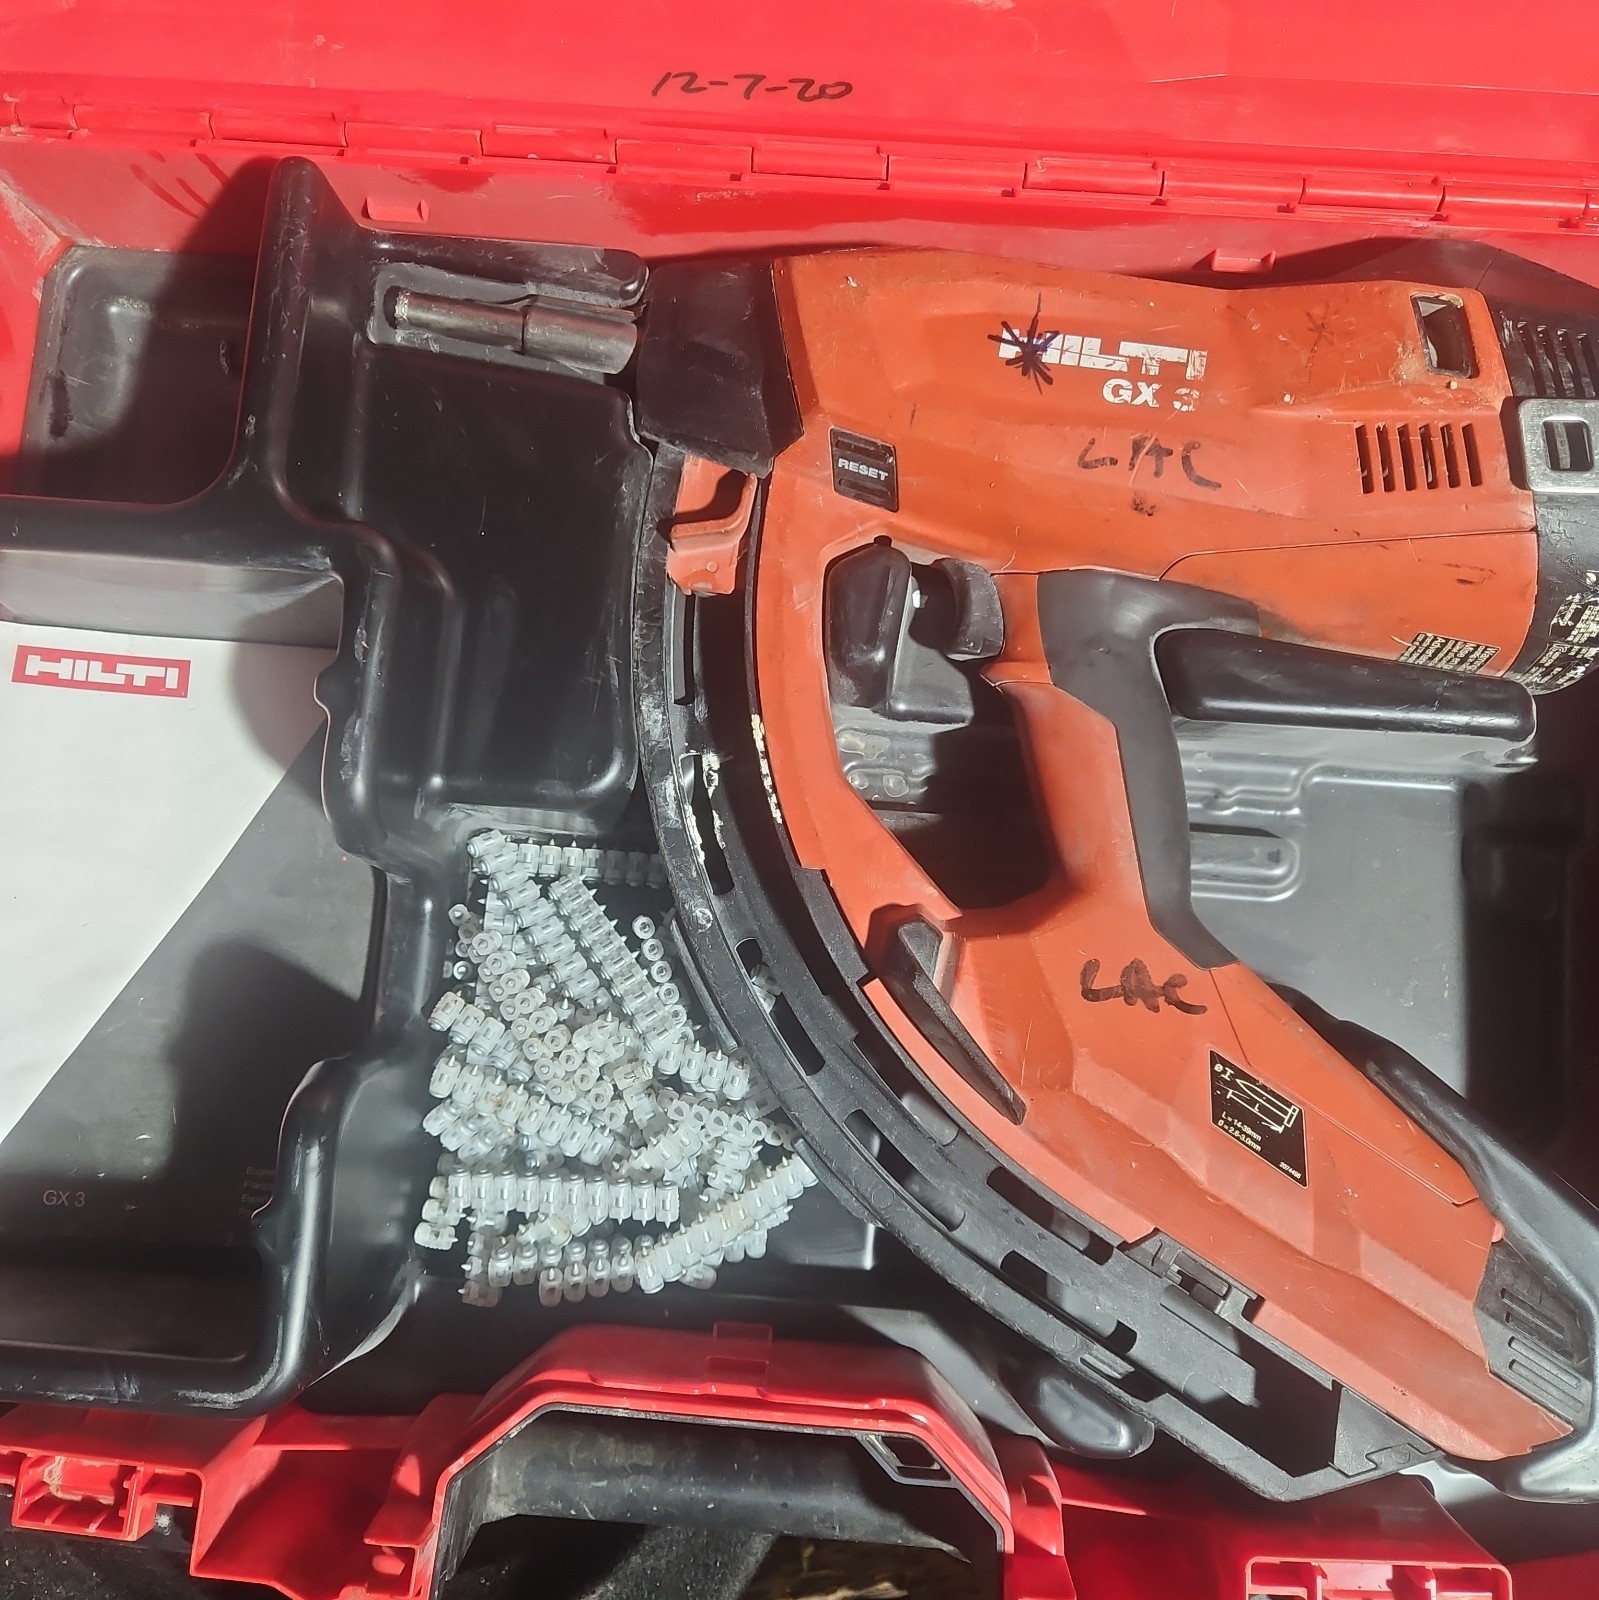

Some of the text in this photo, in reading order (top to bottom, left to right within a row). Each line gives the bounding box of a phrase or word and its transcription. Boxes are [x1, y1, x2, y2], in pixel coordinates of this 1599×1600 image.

[651, 71, 854, 102] 12-7-20
[1102, 378, 1200, 412] GX 3
[837, 457, 889, 481] RESET
[24, 654, 180, 689] HILTI
[42, 1189, 86, 1207] GX 3
